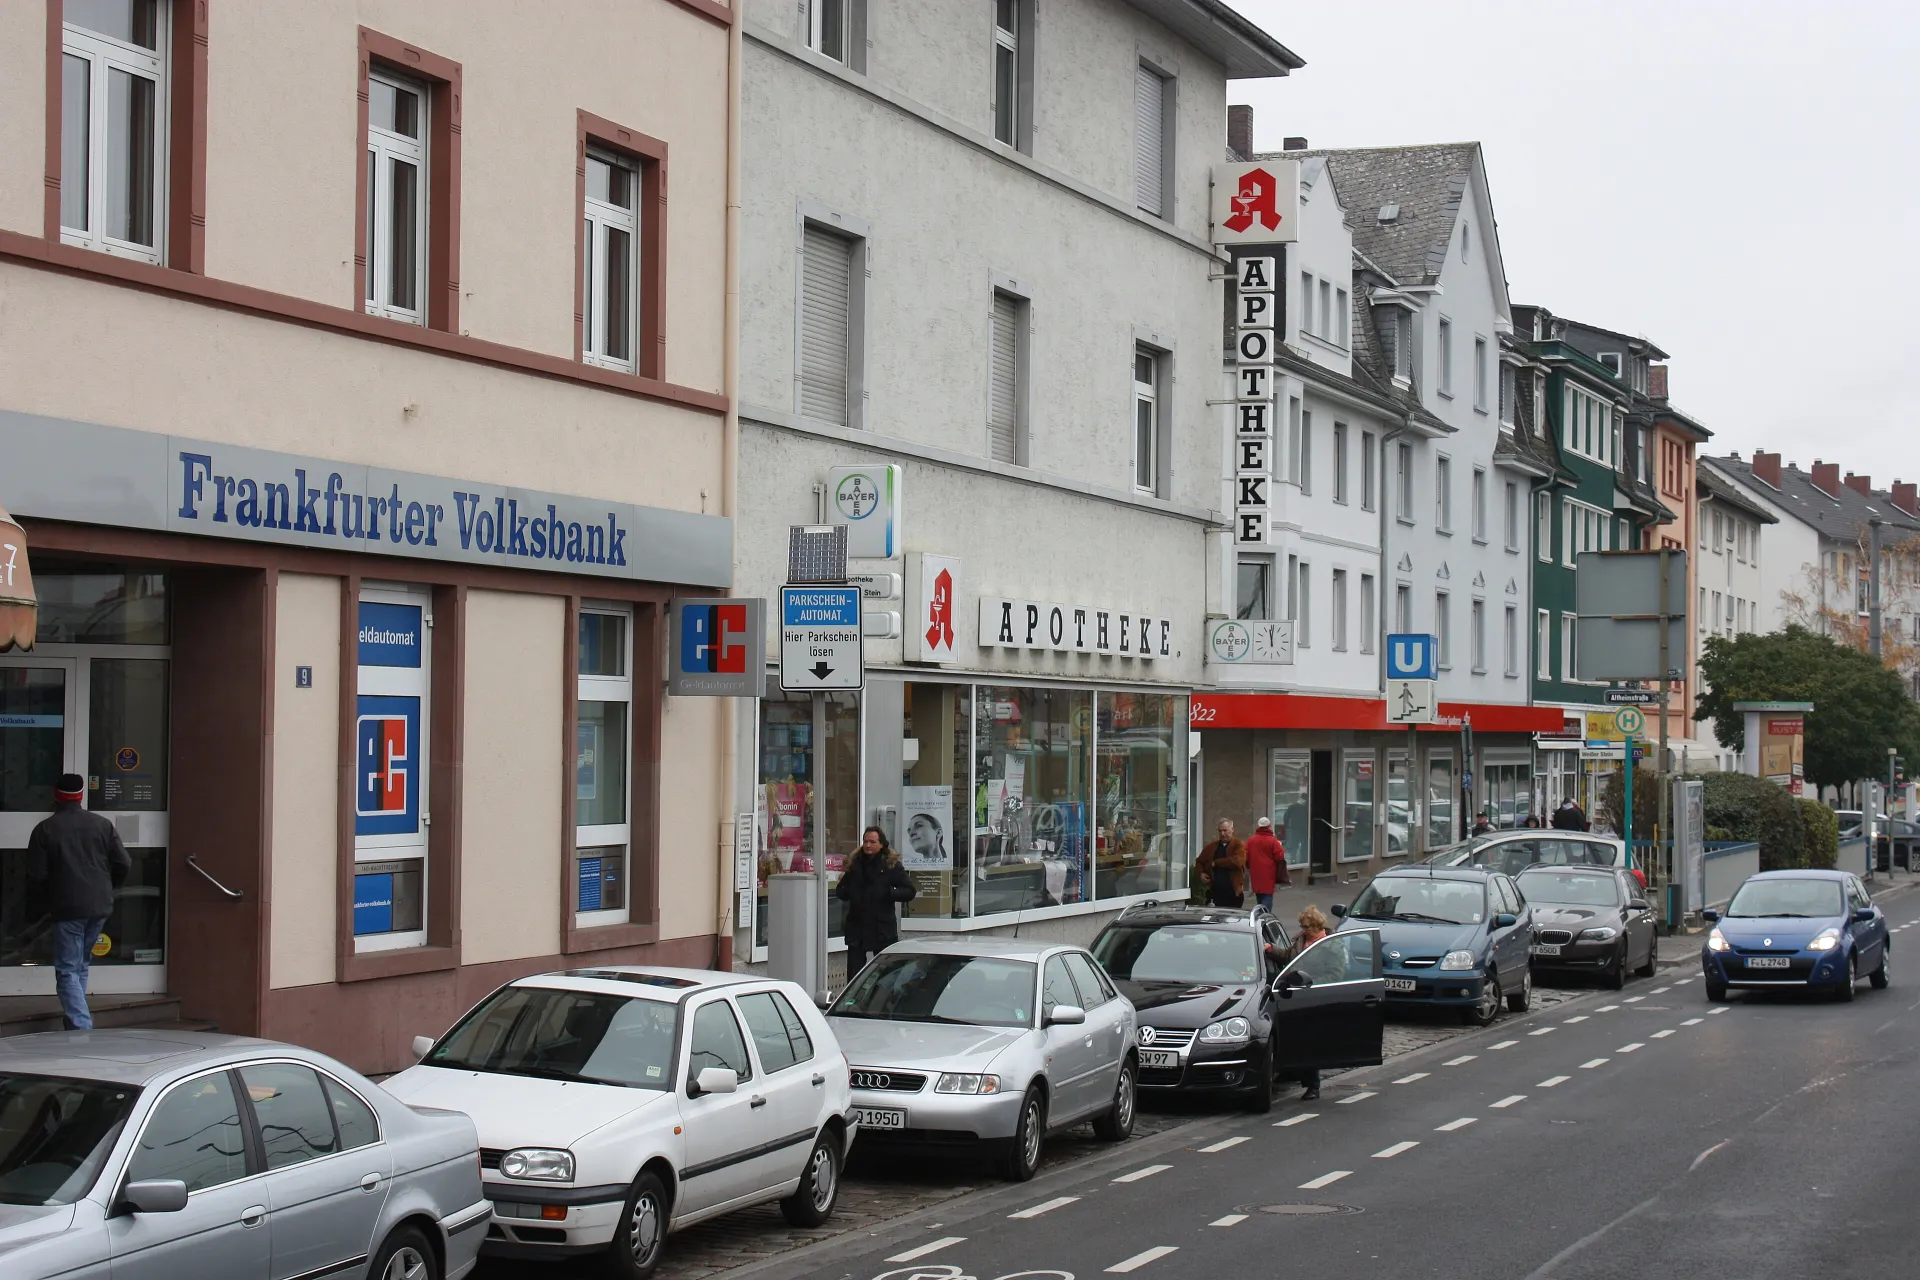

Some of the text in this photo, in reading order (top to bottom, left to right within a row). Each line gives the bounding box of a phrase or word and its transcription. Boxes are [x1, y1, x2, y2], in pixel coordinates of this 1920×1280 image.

[1239, 260, 1268, 542] APOTHEKE
[839, 493, 875, 501] BAYER
[853, 478, 861, 516] BAYER
[178, 451, 627, 567] Frankfurter Volksbank
[864, 589, 881, 597] Stein
[789, 594, 852, 606] PARKSCHEIN-
[800, 609, 842, 621] AUTOMAT
[998, 601, 1170, 656] APOTHEKE
[358, 626, 415, 646] eldautomat
[785, 631, 858, 642] Hier Parkschein
[809, 646, 834, 657] lösen
[1395, 642, 1423, 673] U
[302, 668, 308, 685] 9
[680, 679, 745, 690] Geldautomat
[1623, 713, 1635, 728] H
[1391, 980, 1412, 989] 1417
[1154, 1053, 1169, 1065] 97
[866, 1111, 900, 1127] 1950
